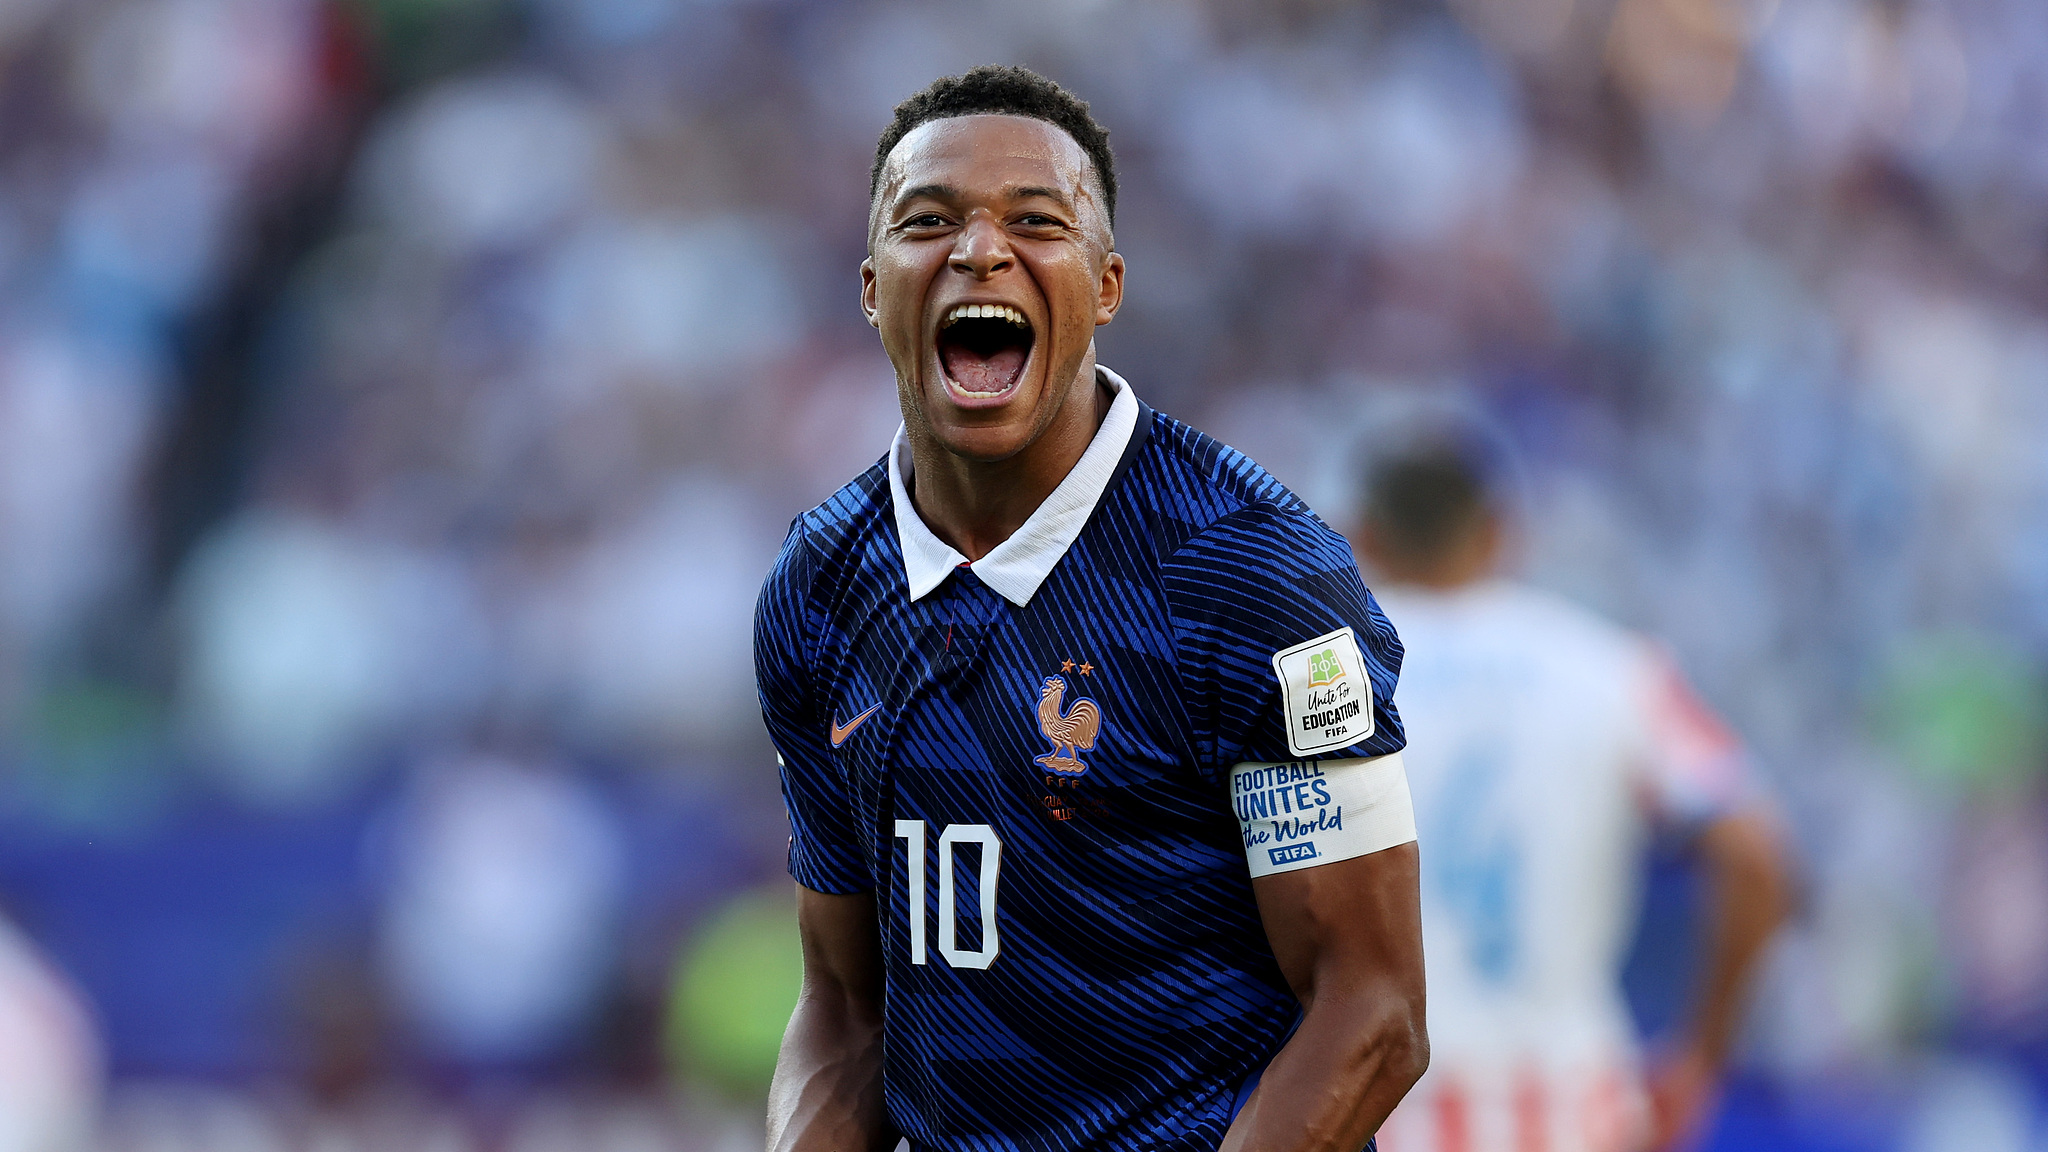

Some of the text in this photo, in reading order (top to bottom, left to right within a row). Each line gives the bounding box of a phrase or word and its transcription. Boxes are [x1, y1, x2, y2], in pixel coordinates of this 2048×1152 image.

[1308, 682, 1350, 711] Unite For
[1302, 699, 1360, 731] EDUCATION
[1325, 725, 1348, 738] FIFA
[1234, 761, 1325, 794] FOOTBALL
[1236, 779, 1331, 822] UNITES
[1243, 805, 1342, 848] the World
[1271, 844, 1314, 863] FIFA
[895, 819, 1003, 970] 10
